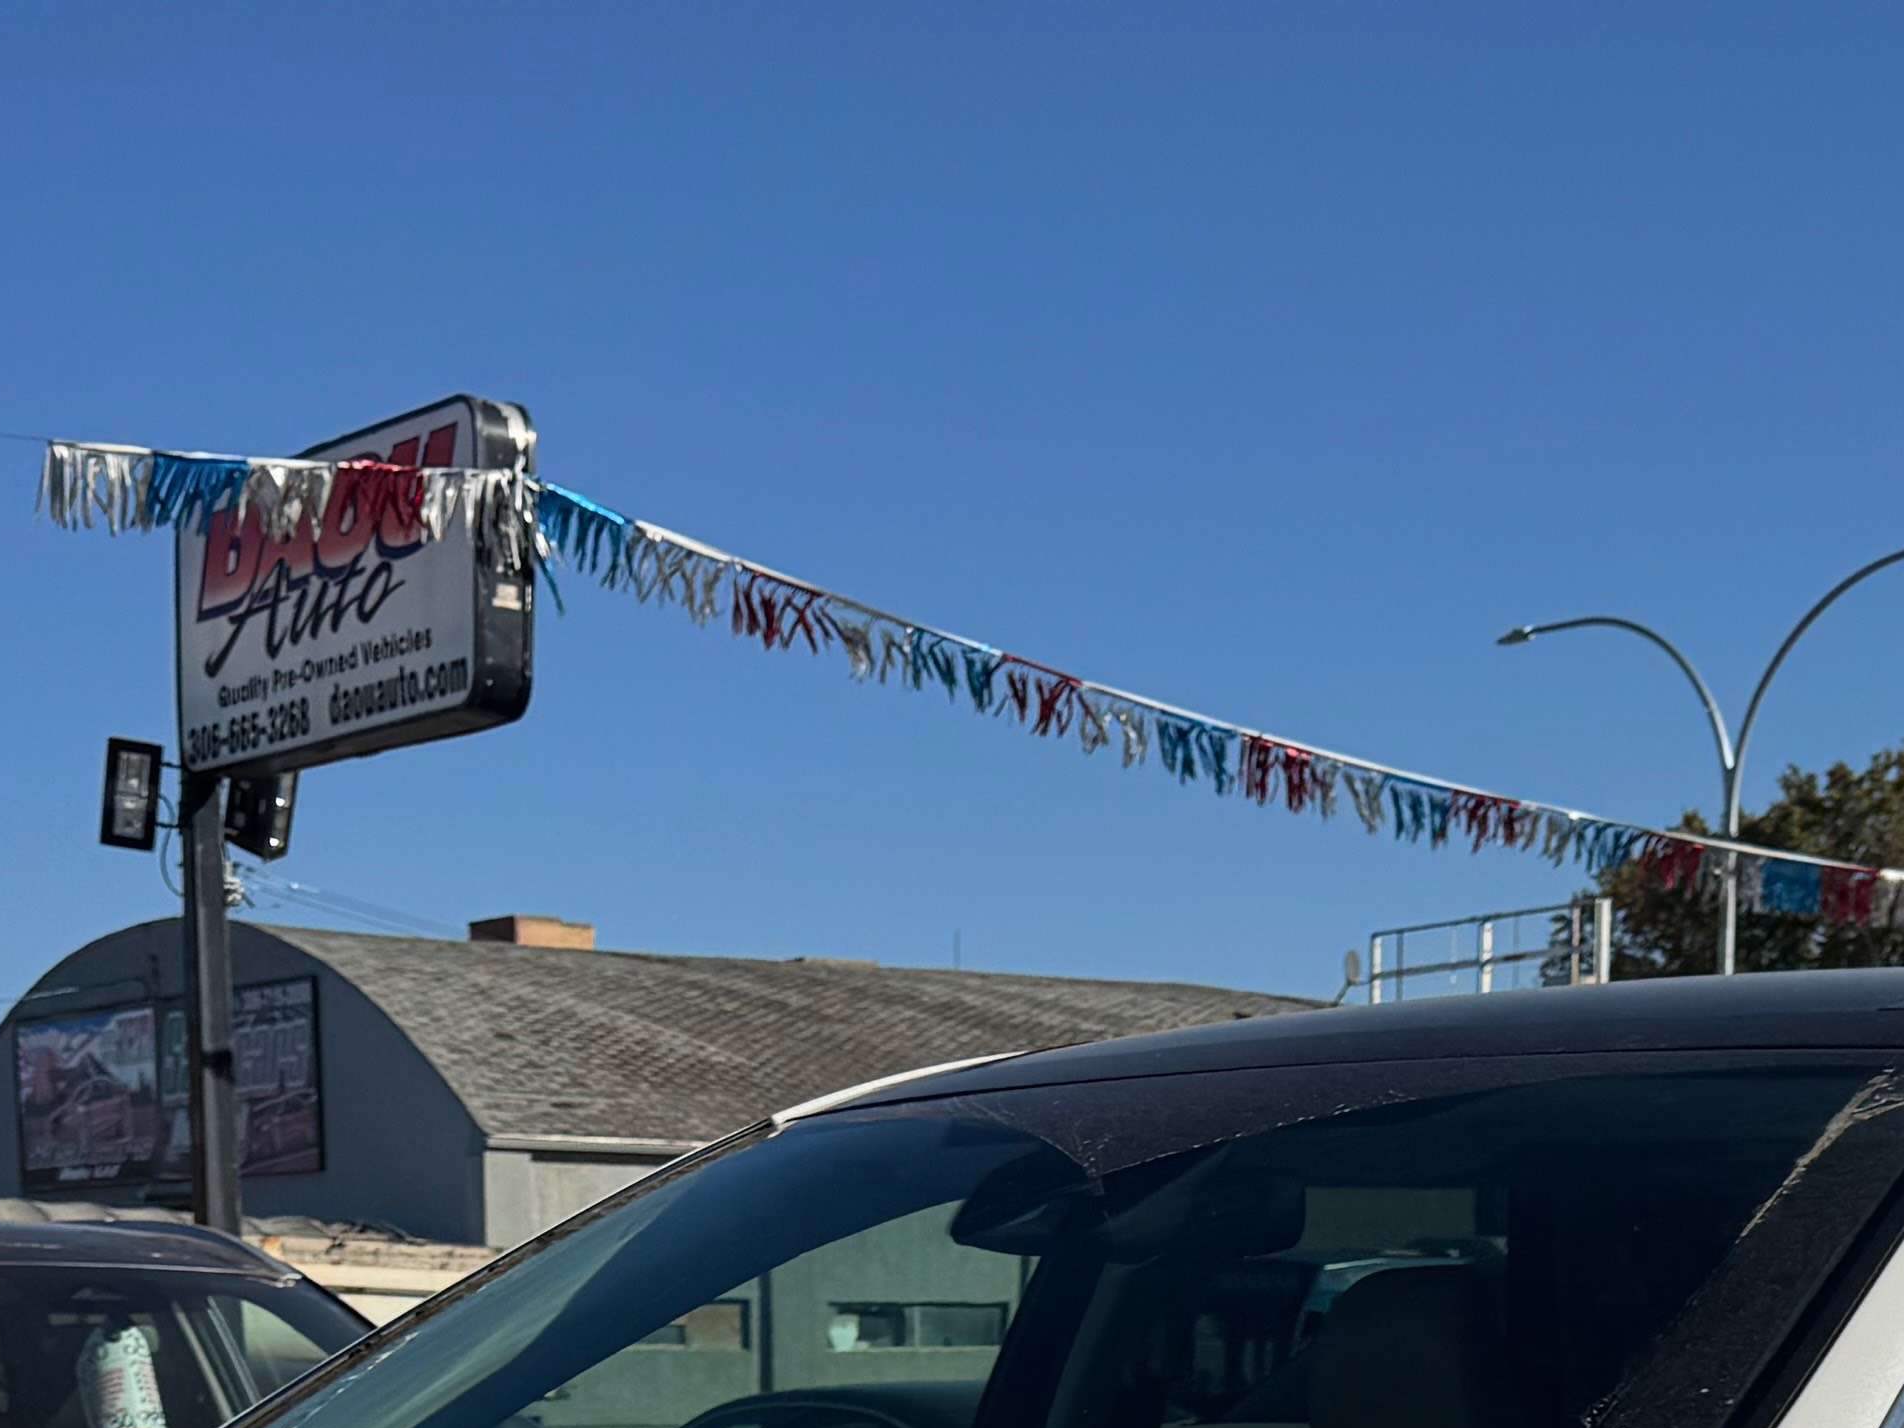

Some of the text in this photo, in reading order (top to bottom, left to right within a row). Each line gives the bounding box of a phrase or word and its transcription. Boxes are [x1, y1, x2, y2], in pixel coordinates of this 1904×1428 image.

[204, 559, 404, 678] Auto
[217, 627, 433, 708] Quality Pre-Owned Vehicles
[186, 696, 311, 765] 306-665-3268
